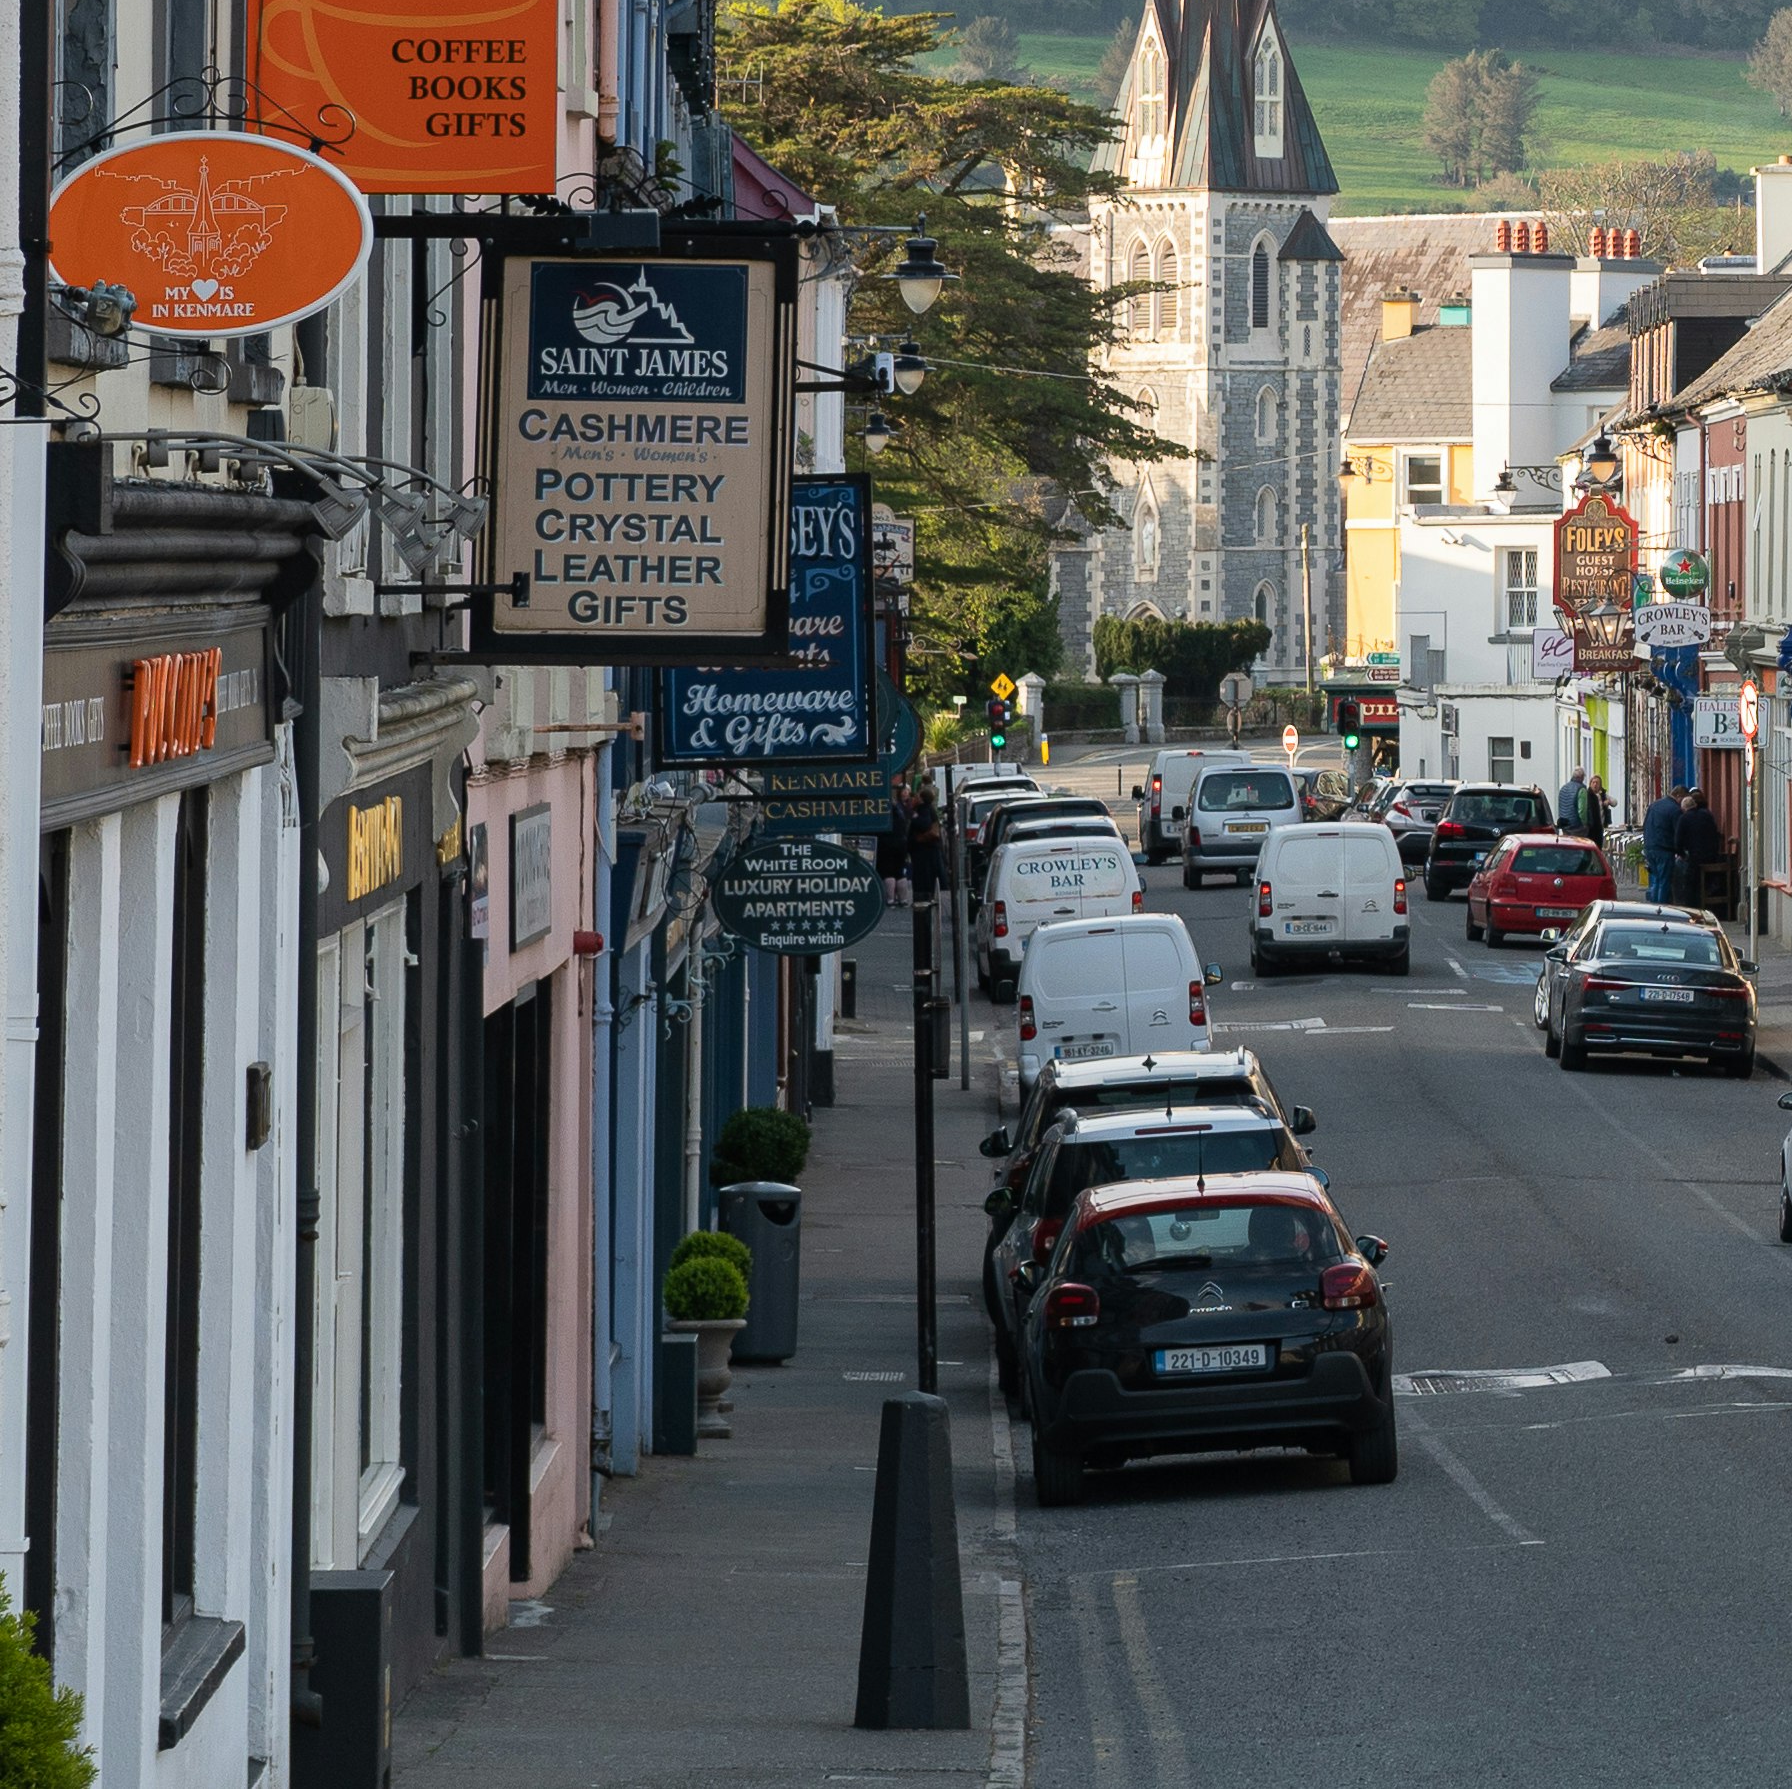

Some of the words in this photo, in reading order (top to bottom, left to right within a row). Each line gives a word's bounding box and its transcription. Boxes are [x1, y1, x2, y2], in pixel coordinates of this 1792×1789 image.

[391, 39, 527, 64] COFFEE
[408, 76, 526, 100] BOOKS
[426, 113, 526, 137] GIFTS
[165, 287, 190, 300] MY
[219, 286, 234, 300] IS
[152, 304, 168, 318] IN
[174, 303, 256, 318] KENMARE
[541, 347, 629, 375] SAINT
[634, 349, 728, 378] JAMES
[540, 380, 579, 394] Men
[591, 381, 650, 395] Women
[662, 382, 733, 397] Children
[518, 408, 750, 446] CASHMERE
[561, 446, 614, 462] Men's
[534, 468, 725, 504] POTTERY
[535, 508, 725, 545] CRYSTAL
[534, 549, 725, 586] LEATHER
[1576, 556, 1615, 566] GUEST
[1665, 577, 1704, 585] Heineken
[568, 590, 689, 626] GIFTS
[1637, 608, 1708, 626] CROWLEY'S
[1660, 624, 1685, 636] BAR
[1578, 649, 1635, 660] BREAKFAST
[682, 684, 857, 716] Homeware
[690, 717, 718, 748] &
[725, 712, 808, 755] Gifts
[772, 771, 884, 791] KENMARE
[765, 799, 891, 819] CASHMERE
[780, 843, 812, 856] THE
[744, 859, 798, 872] WHITE
[802, 858, 848, 870] ROOM
[1017, 857, 1117, 875] CROWLEY'S
[724, 878, 792, 895] LUXURY
[797, 876, 873, 894] HOLIDAY
[1051, 874, 1085, 888] BAR
[743, 900, 855, 918] APARTMENTS
[760, 933, 806, 949] Enquire
[808, 933, 844, 945] within
[1171, 1350, 1259, 1369] 221-D-10349
